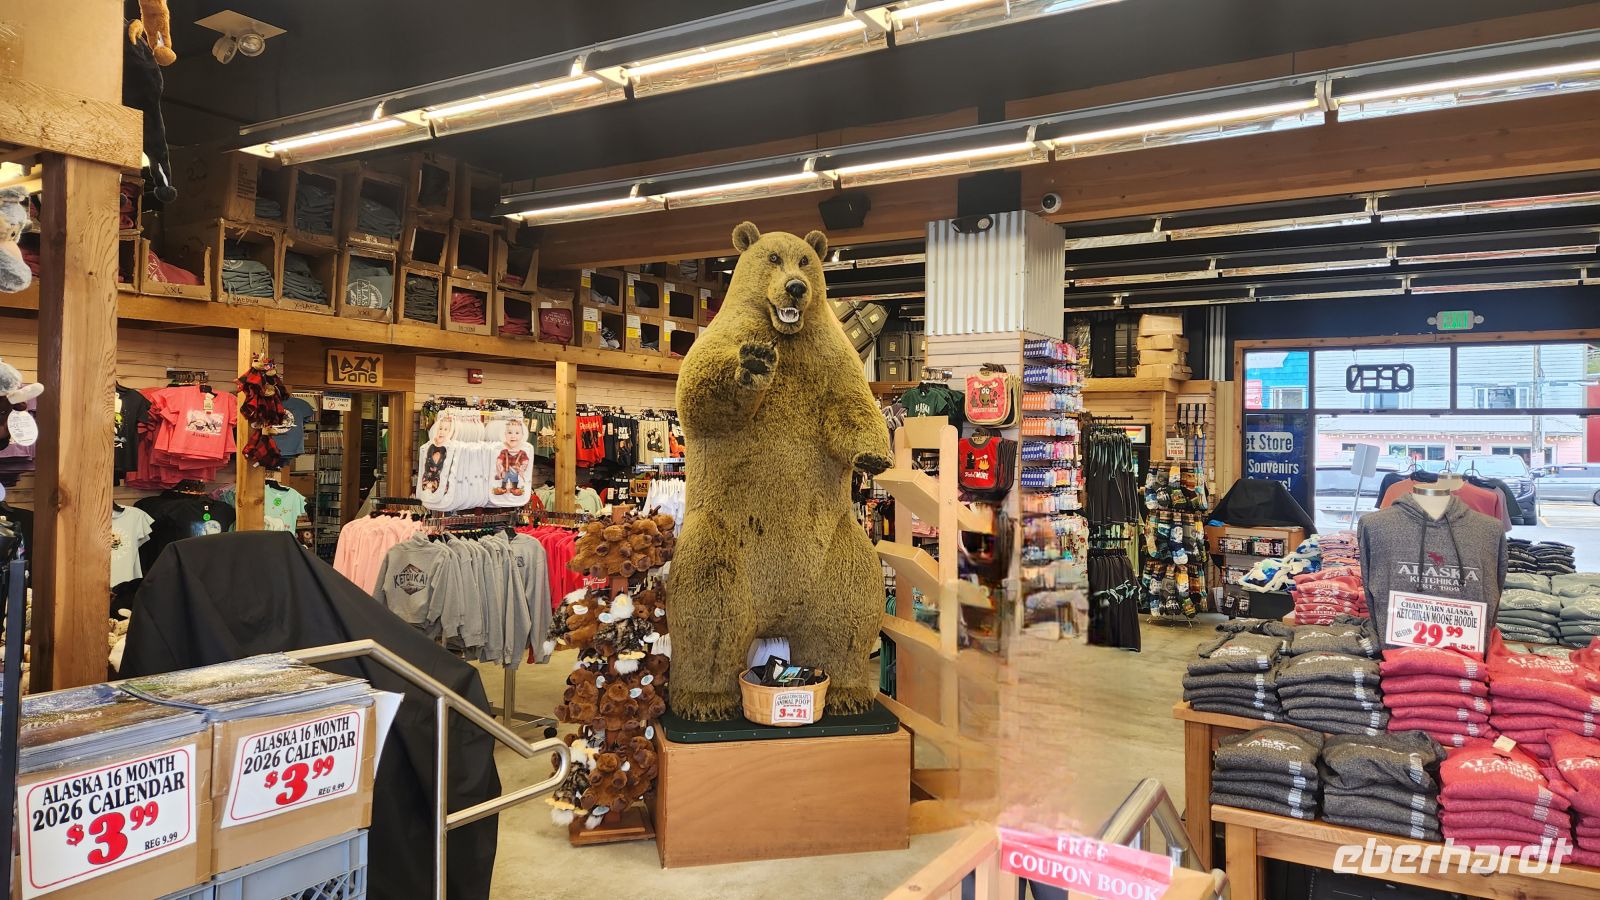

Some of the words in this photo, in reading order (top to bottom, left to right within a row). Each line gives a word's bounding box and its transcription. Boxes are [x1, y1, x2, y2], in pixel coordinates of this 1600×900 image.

[163, 286, 183, 295] XXL
[331, 354, 380, 382] LAZY
[1259, 432, 1293, 450] Store
[1248, 459, 1299, 475] Souvenirs
[1396, 608, 1431, 622] KETCHIKAN
[1431, 611, 1453, 625] MOOSE
[1454, 615, 1478, 628] HOODIE
[1401, 601, 1424, 610] CHAIN
[1424, 604, 1444, 613] YARN
[1445, 607, 1474, 616] ALASKA
[253, 729, 297, 753] ALASKA
[300, 726, 312, 743] 16
[313, 716, 350, 738] MONTH
[243, 751, 281, 775] 2026
[284, 731, 357, 763] CALENDAR
[42, 775, 103, 806] ALASKA
[106, 767, 122, 788] 16
[125, 754, 176, 784] MONTH
[318, 785, 331, 796] REG
[331, 782, 345, 793] 9.99
[32, 801, 83, 832] 2026
[88, 770, 186, 814] CALENDAR
[144, 835, 162, 851] REG
[162, 831, 178, 847] 9.99
[1057, 835, 1109, 862] FREE
[1009, 851, 1092, 887] COUPON
[1098, 876, 1161, 900] BOOK
